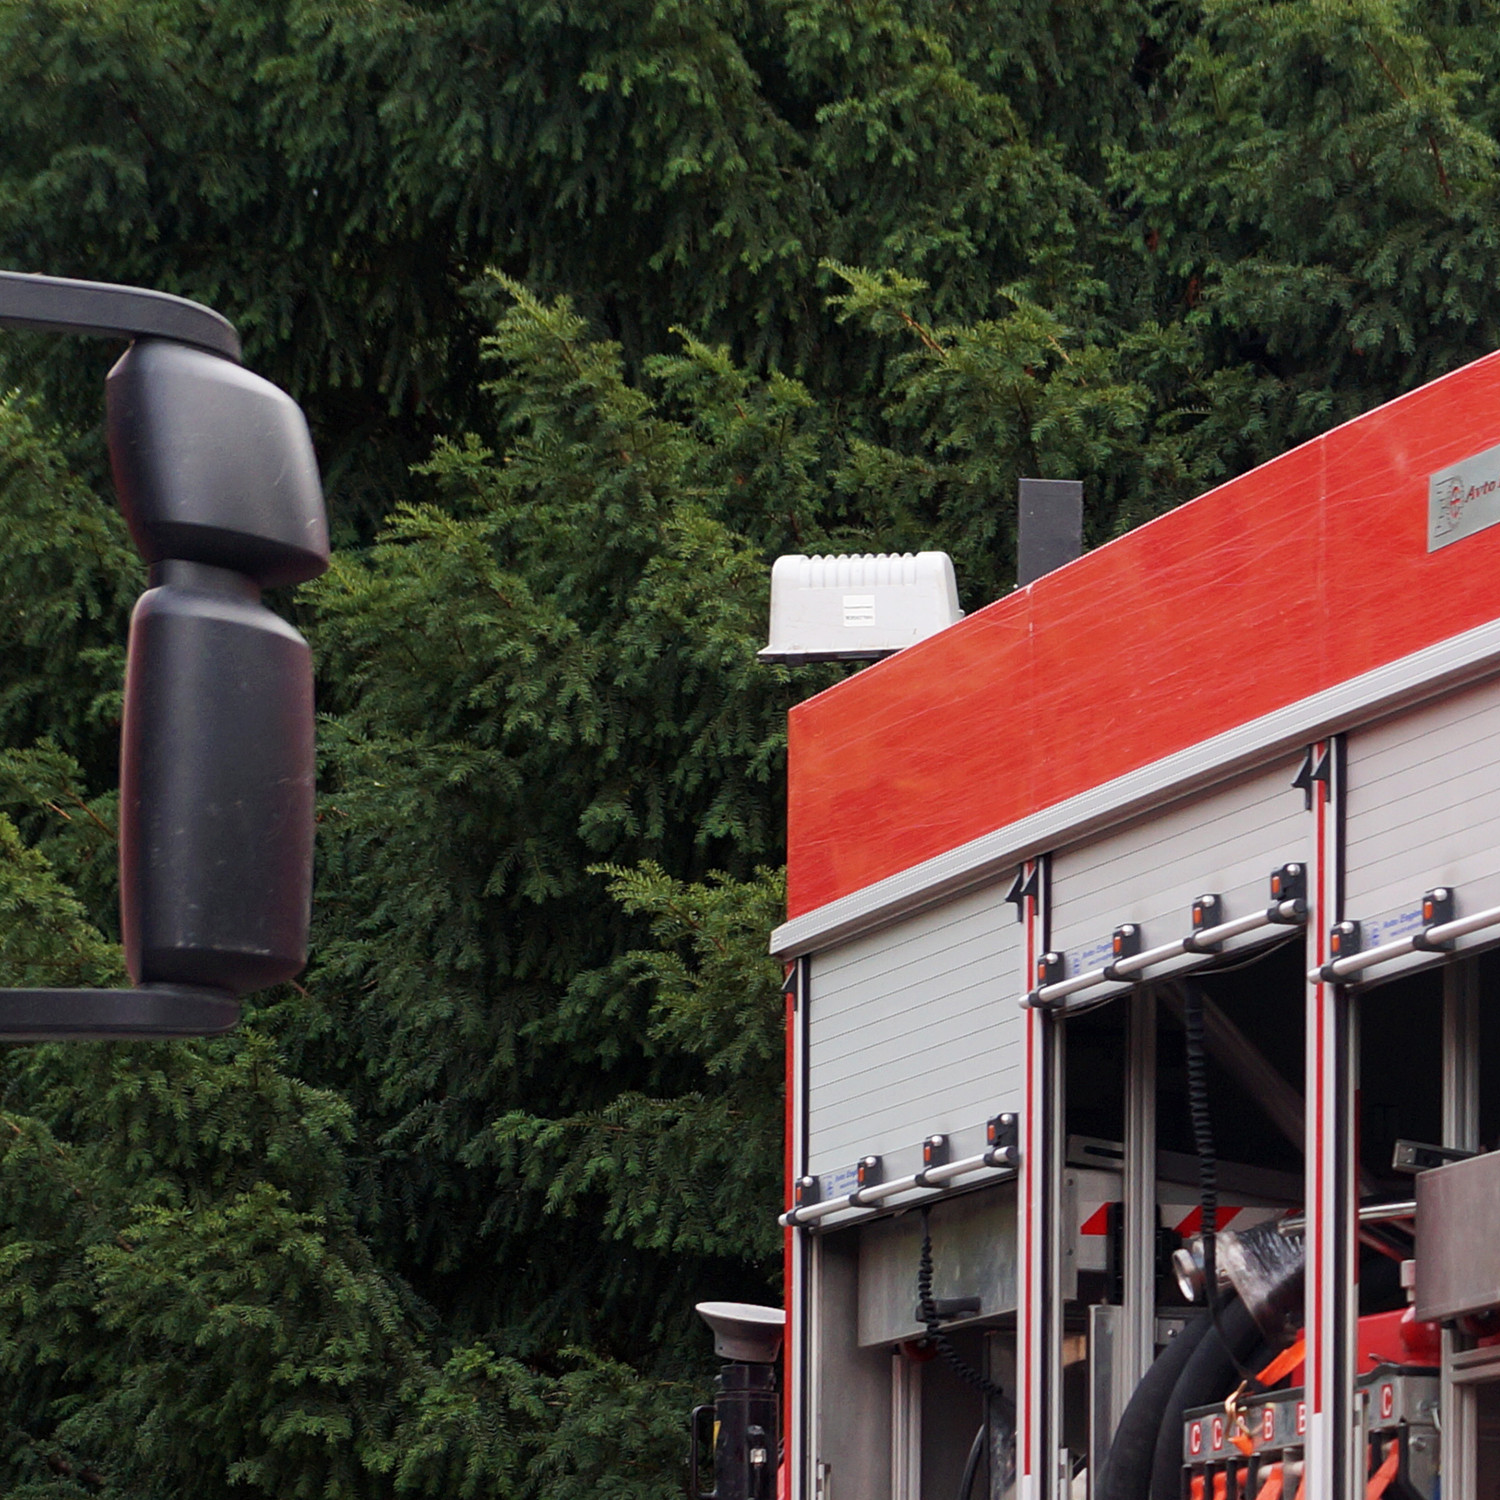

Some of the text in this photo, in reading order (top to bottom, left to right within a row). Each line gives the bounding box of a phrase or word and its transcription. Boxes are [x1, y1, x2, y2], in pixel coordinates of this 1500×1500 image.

[1465, 480, 1496, 502] Avto
[1192, 1424, 1201, 1453] C
[1213, 1421, 1221, 1448] C
[1264, 1411, 1273, 1440] B
